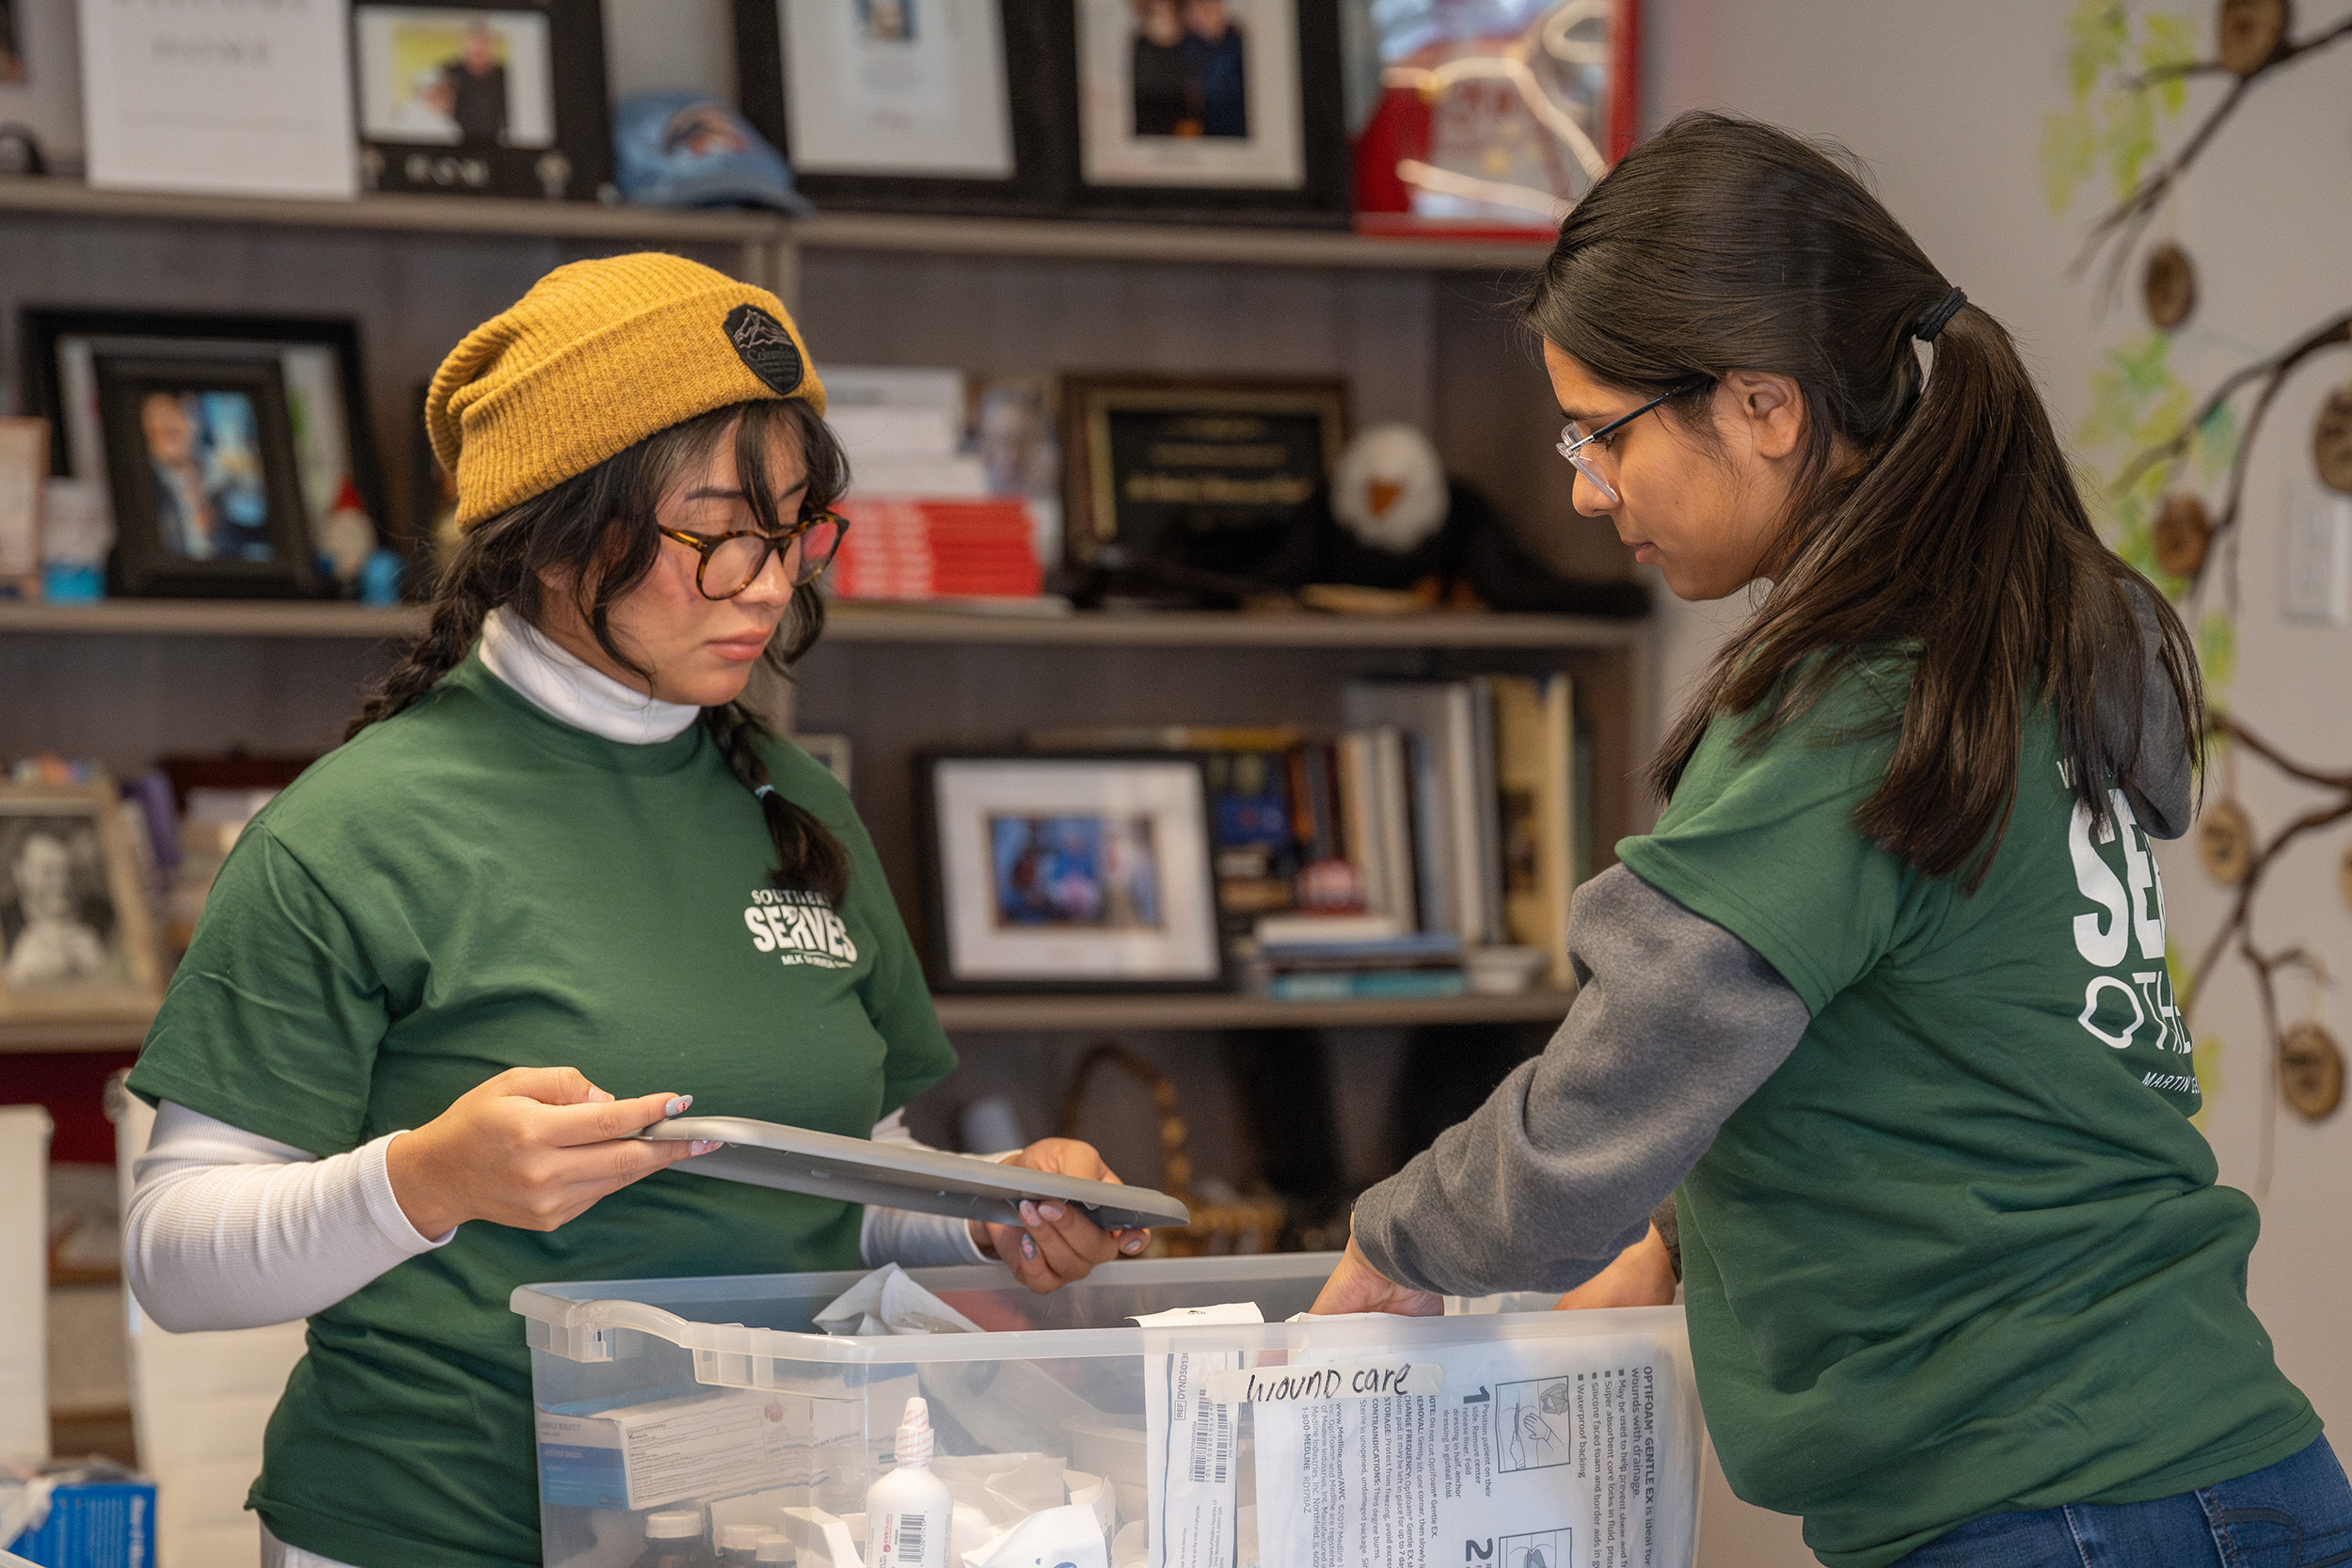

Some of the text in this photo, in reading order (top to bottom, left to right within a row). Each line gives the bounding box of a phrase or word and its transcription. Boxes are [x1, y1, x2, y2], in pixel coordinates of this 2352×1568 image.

[2069, 788, 2167, 968] SE
[751, 889, 834, 908] SOUTHER
[744, 905, 857, 962] SERVES
[2142, 1071, 2191, 1092] MARTIN
[1463, 1386, 1490, 1404] 1
[1591, 1382, 1600, 1418] Silicone
[1604, 1381, 1613, 1407] Super
[1616, 1380, 1626, 1400] May
[1618, 1402, 1627, 1413] be
[1395, 1417, 1404, 1433] pad.
[1429, 1418, 1436, 1428] Do
[1441, 1410, 1450, 1443] dressing
[1577, 1385, 1587, 1478] Waterproof backing
[1593, 1421, 1601, 1446] faced
[1619, 1416, 1628, 1437] used
[1630, 1368, 1643, 1498] wounds with drainage.
[1302, 1406, 1311, 1470] 1-800-MEDLINE
[1373, 1399, 1381, 1486] CONTRAINDICATIONS:
[1416, 1436, 1424, 1461] Gently
[1621, 1440, 1627, 1449] to
[1336, 1402, 1345, 1500] www.Medline.com/AWC
[1395, 1442, 1404, 1458] may
[1405, 1430, 1413, 1480] FREQUENCY:
[1481, 1437, 1490, 1465] patient
[1645, 1437, 1654, 1484] GENTLE
[1397, 1460, 1404, 1469] be
[1442, 1453, 1451, 1481] gluteal
[1485, 1468, 1490, 1477] on
[1619, 1452, 1628, 1472] help
[1359, 1477, 1368, 1522] undamaged
[1373, 1487, 1381, 1507] Third
[1396, 1485, 1404, 1494] in
[1618, 1475, 1627, 1511] prevent
[1645, 1488, 1654, 1503] EX
[1394, 1495, 1404, 1514] place
[1645, 1507, 1653, 1515] is
[1320, 1507, 1328, 1562] Manufactured
[1359, 1523, 1368, 1556] package.
[1385, 1523, 1393, 1544] avoid
[1397, 1529, 1404, 1540] up
[1645, 1518, 1653, 1545] ideal
[1312, 1542, 1320, 1550] IL
[1327, 1528, 1336, 1567] registered
[1399, 1541, 1405, 1549] to
[1407, 1550, 1414, 1560] EX
[1465, 1538, 1493, 1561] 2
[1595, 1549, 1602, 1558] in
